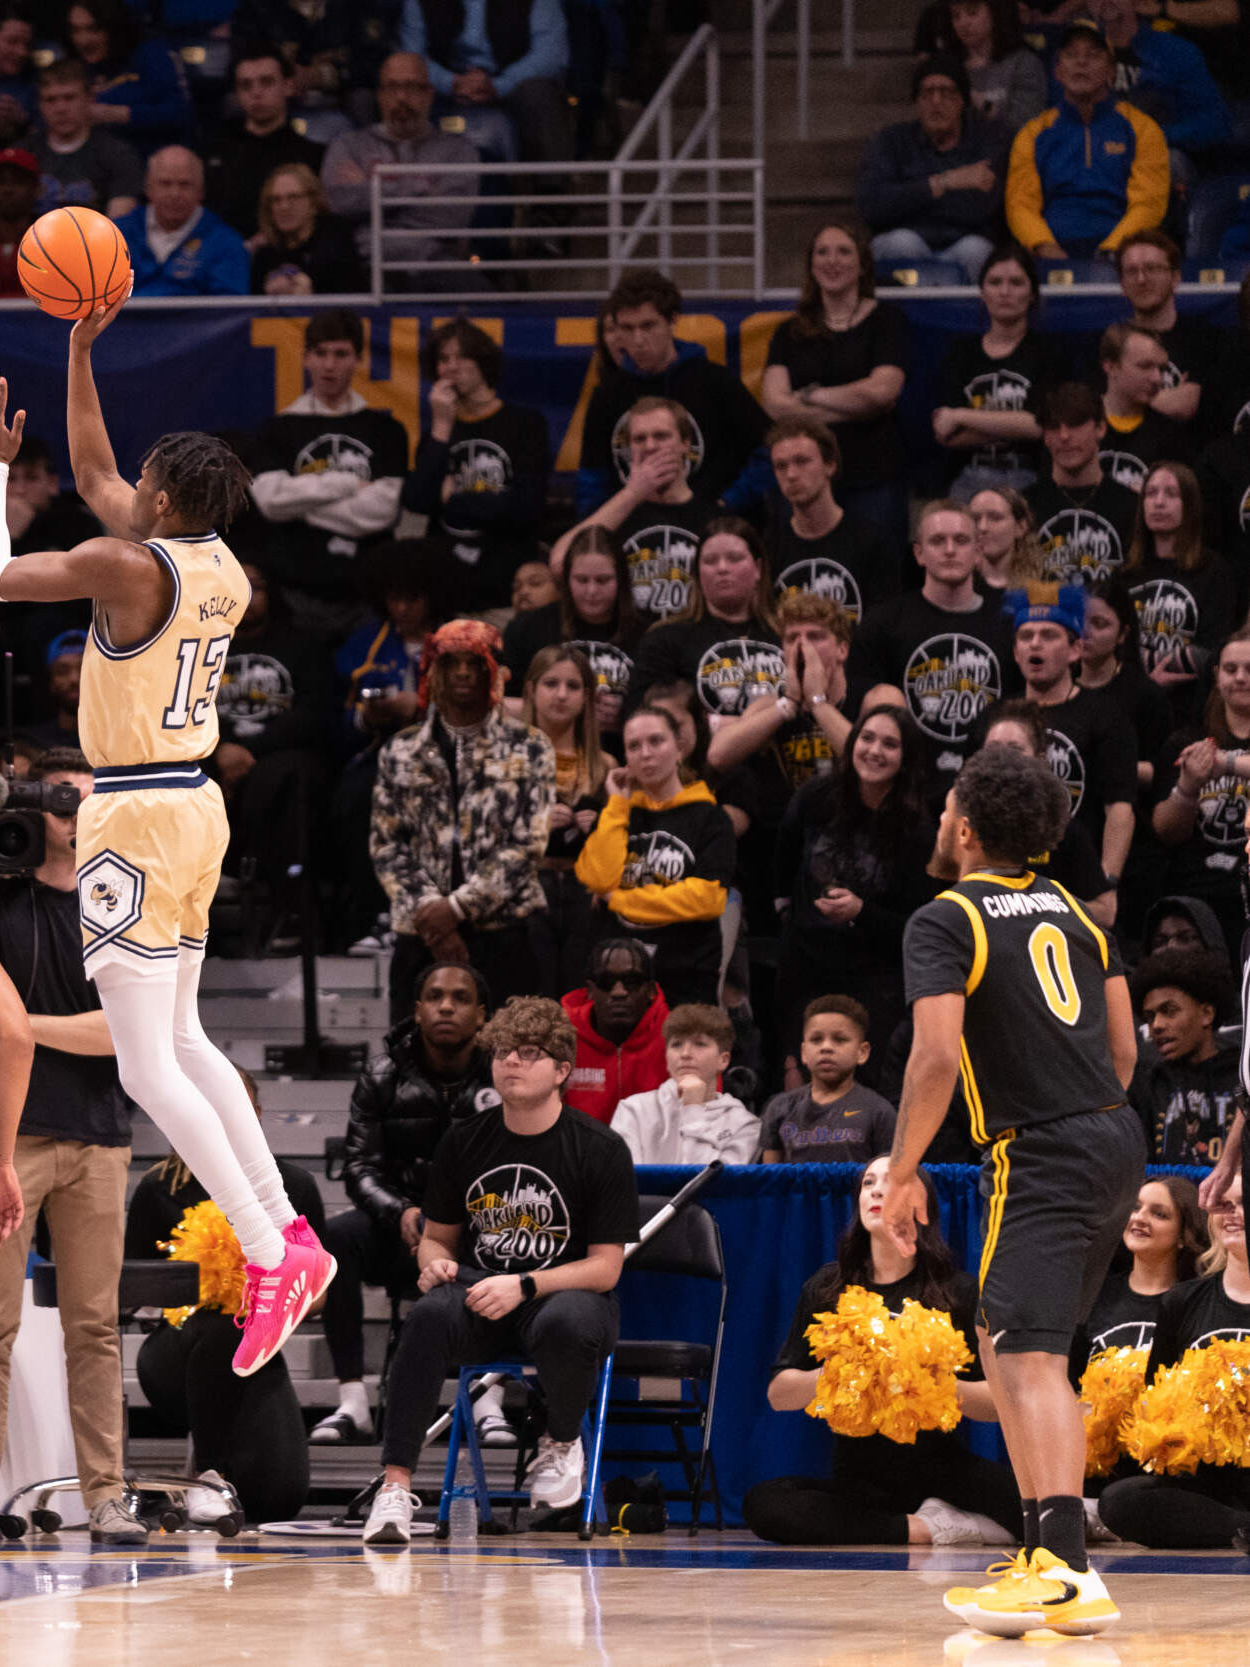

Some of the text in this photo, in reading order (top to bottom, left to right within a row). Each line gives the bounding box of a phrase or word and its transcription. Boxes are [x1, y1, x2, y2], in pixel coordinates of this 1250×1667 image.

[198, 595, 237, 622] KELLY
[161, 634, 231, 729] 13
[915, 664, 991, 694] OAKLAND
[1028, 921, 1081, 1026] 0
[779, 1121, 865, 1146] Panthers
[472, 1201, 554, 1232] OAKLAND
[493, 1226, 555, 1260] ZOO
